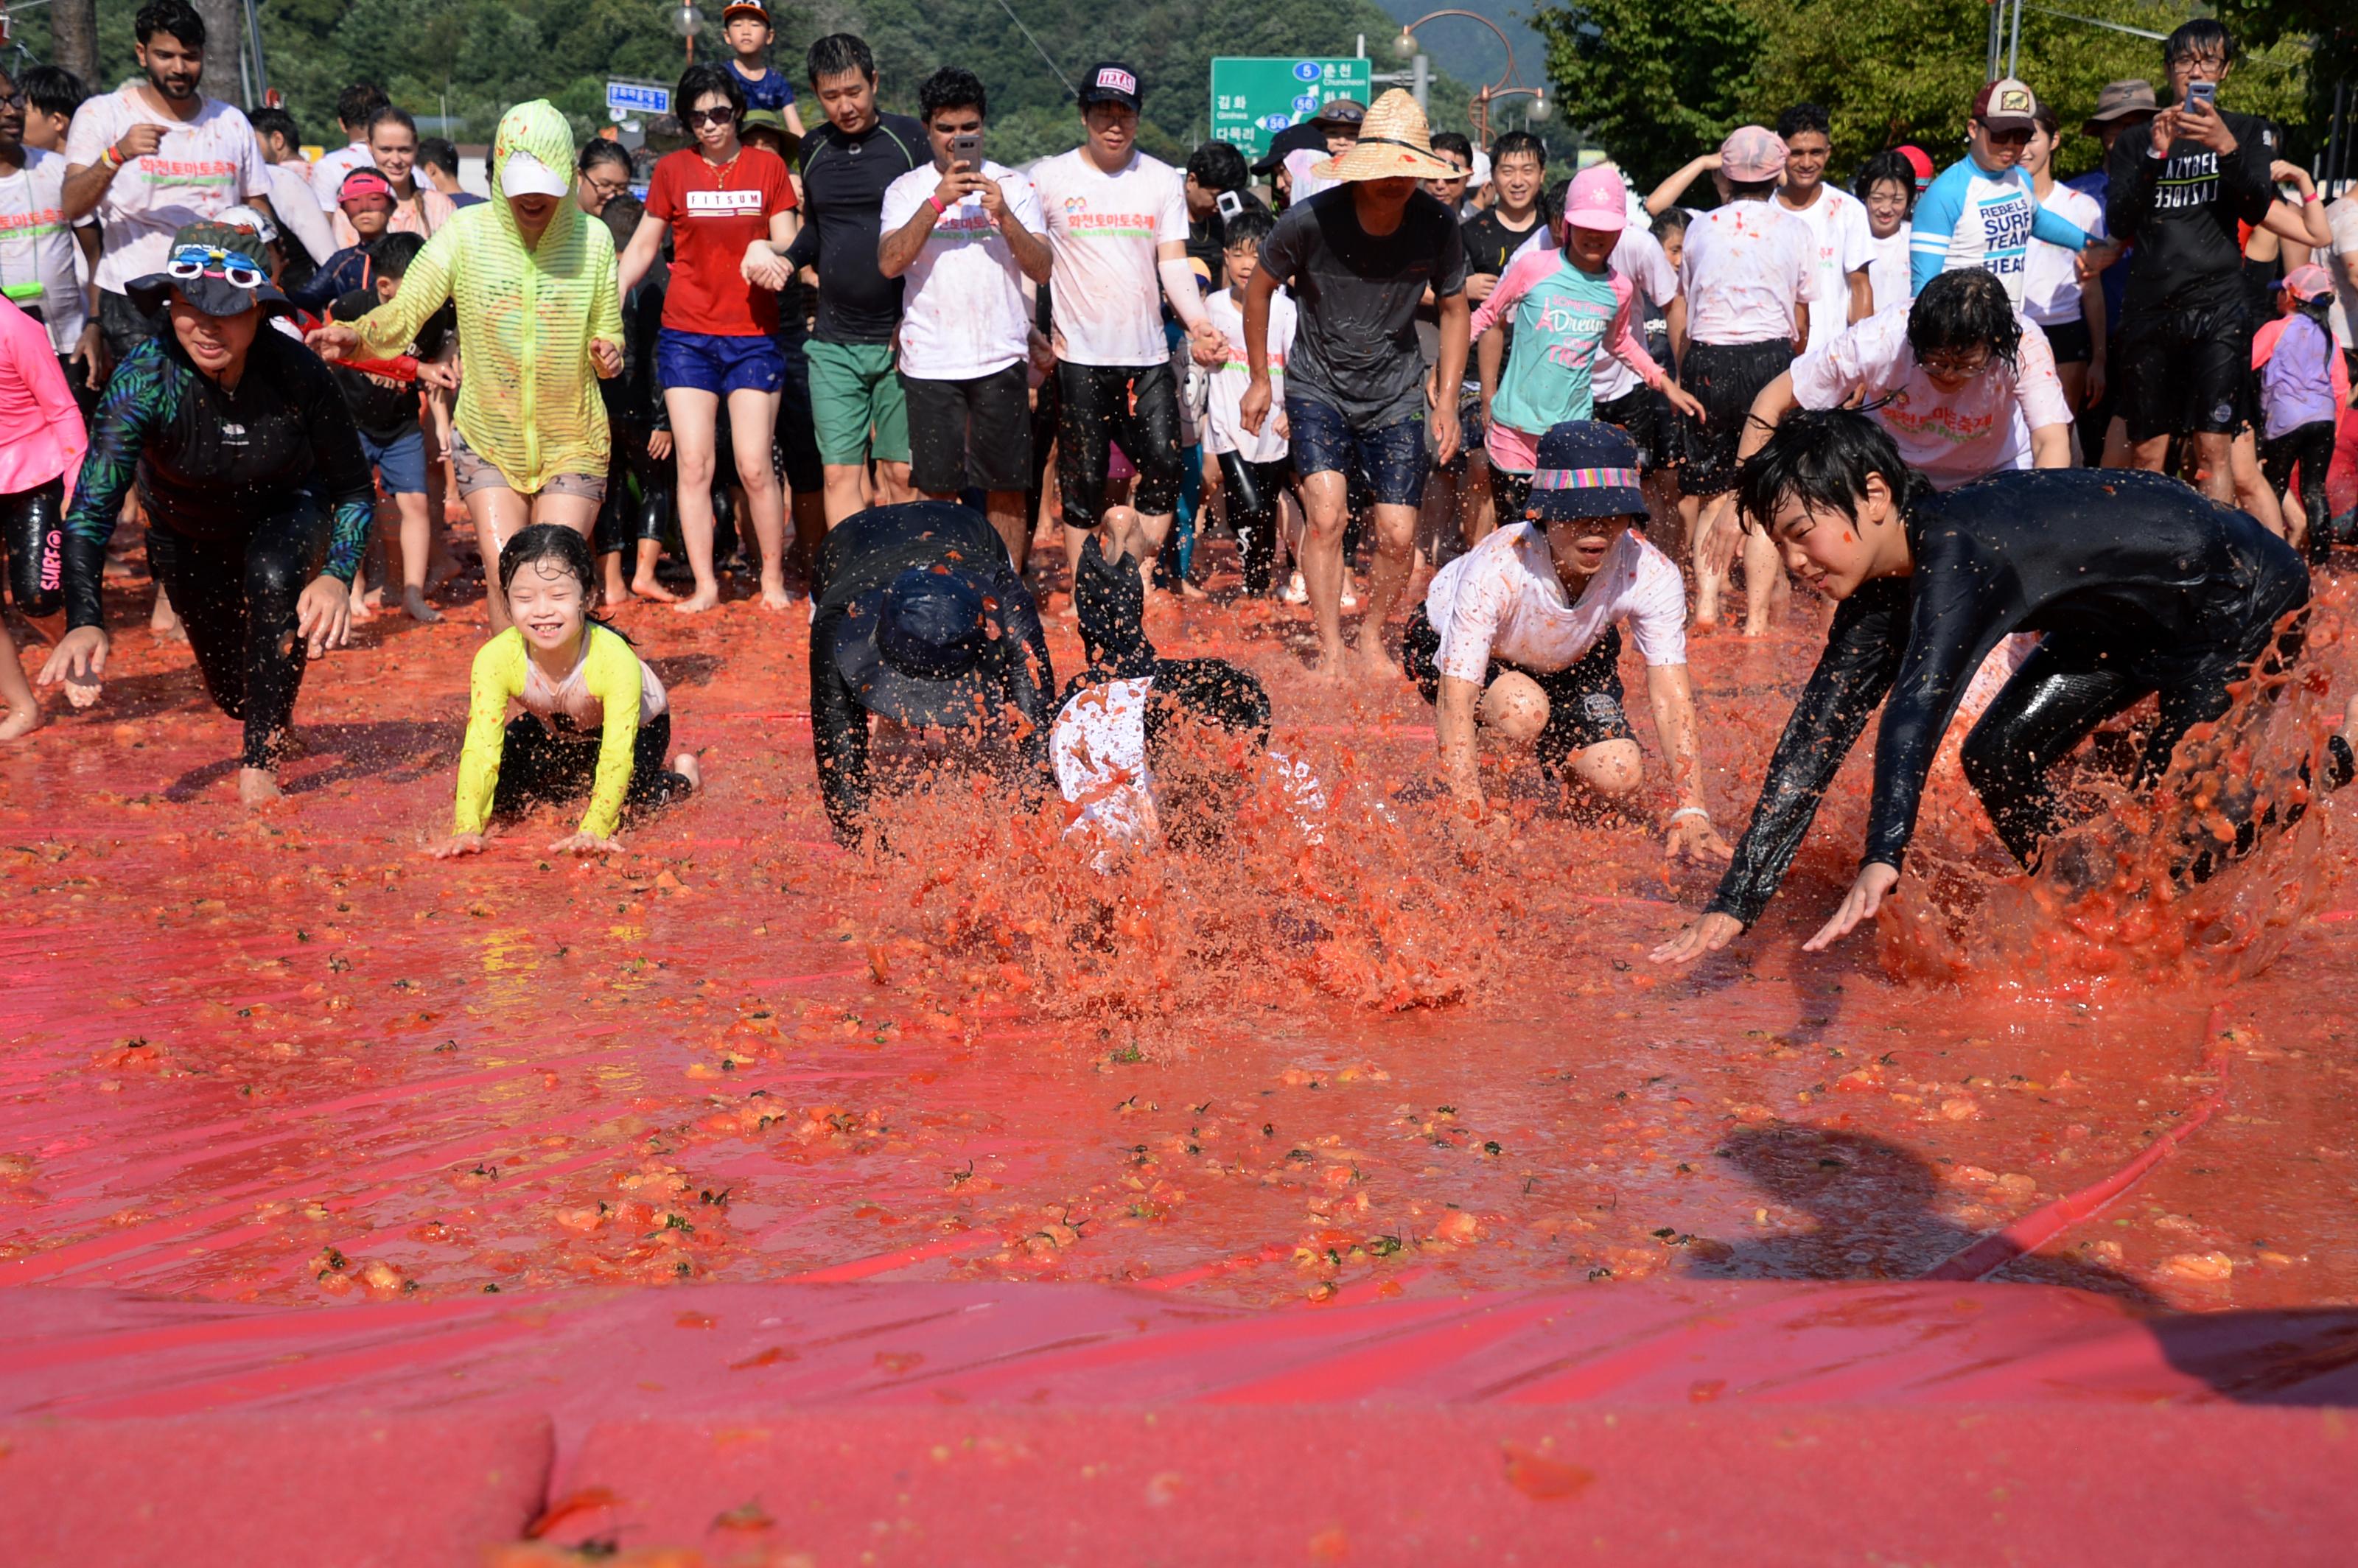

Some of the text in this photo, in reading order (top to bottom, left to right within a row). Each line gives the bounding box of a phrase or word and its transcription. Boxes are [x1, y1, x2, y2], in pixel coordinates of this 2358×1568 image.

[1303, 65, 1312, 78] 5
[1100, 71, 1133, 89] TEXAS
[1217, 95, 1247, 110] 김화
[1296, 99, 1313, 110] 56
[1269, 117, 1285, 129] 56
[691, 195, 758, 205] FITSUM
[1980, 199, 2028, 218] REBELS
[1984, 211, 2030, 234] SURF
[41, 547, 61, 590] SURF
